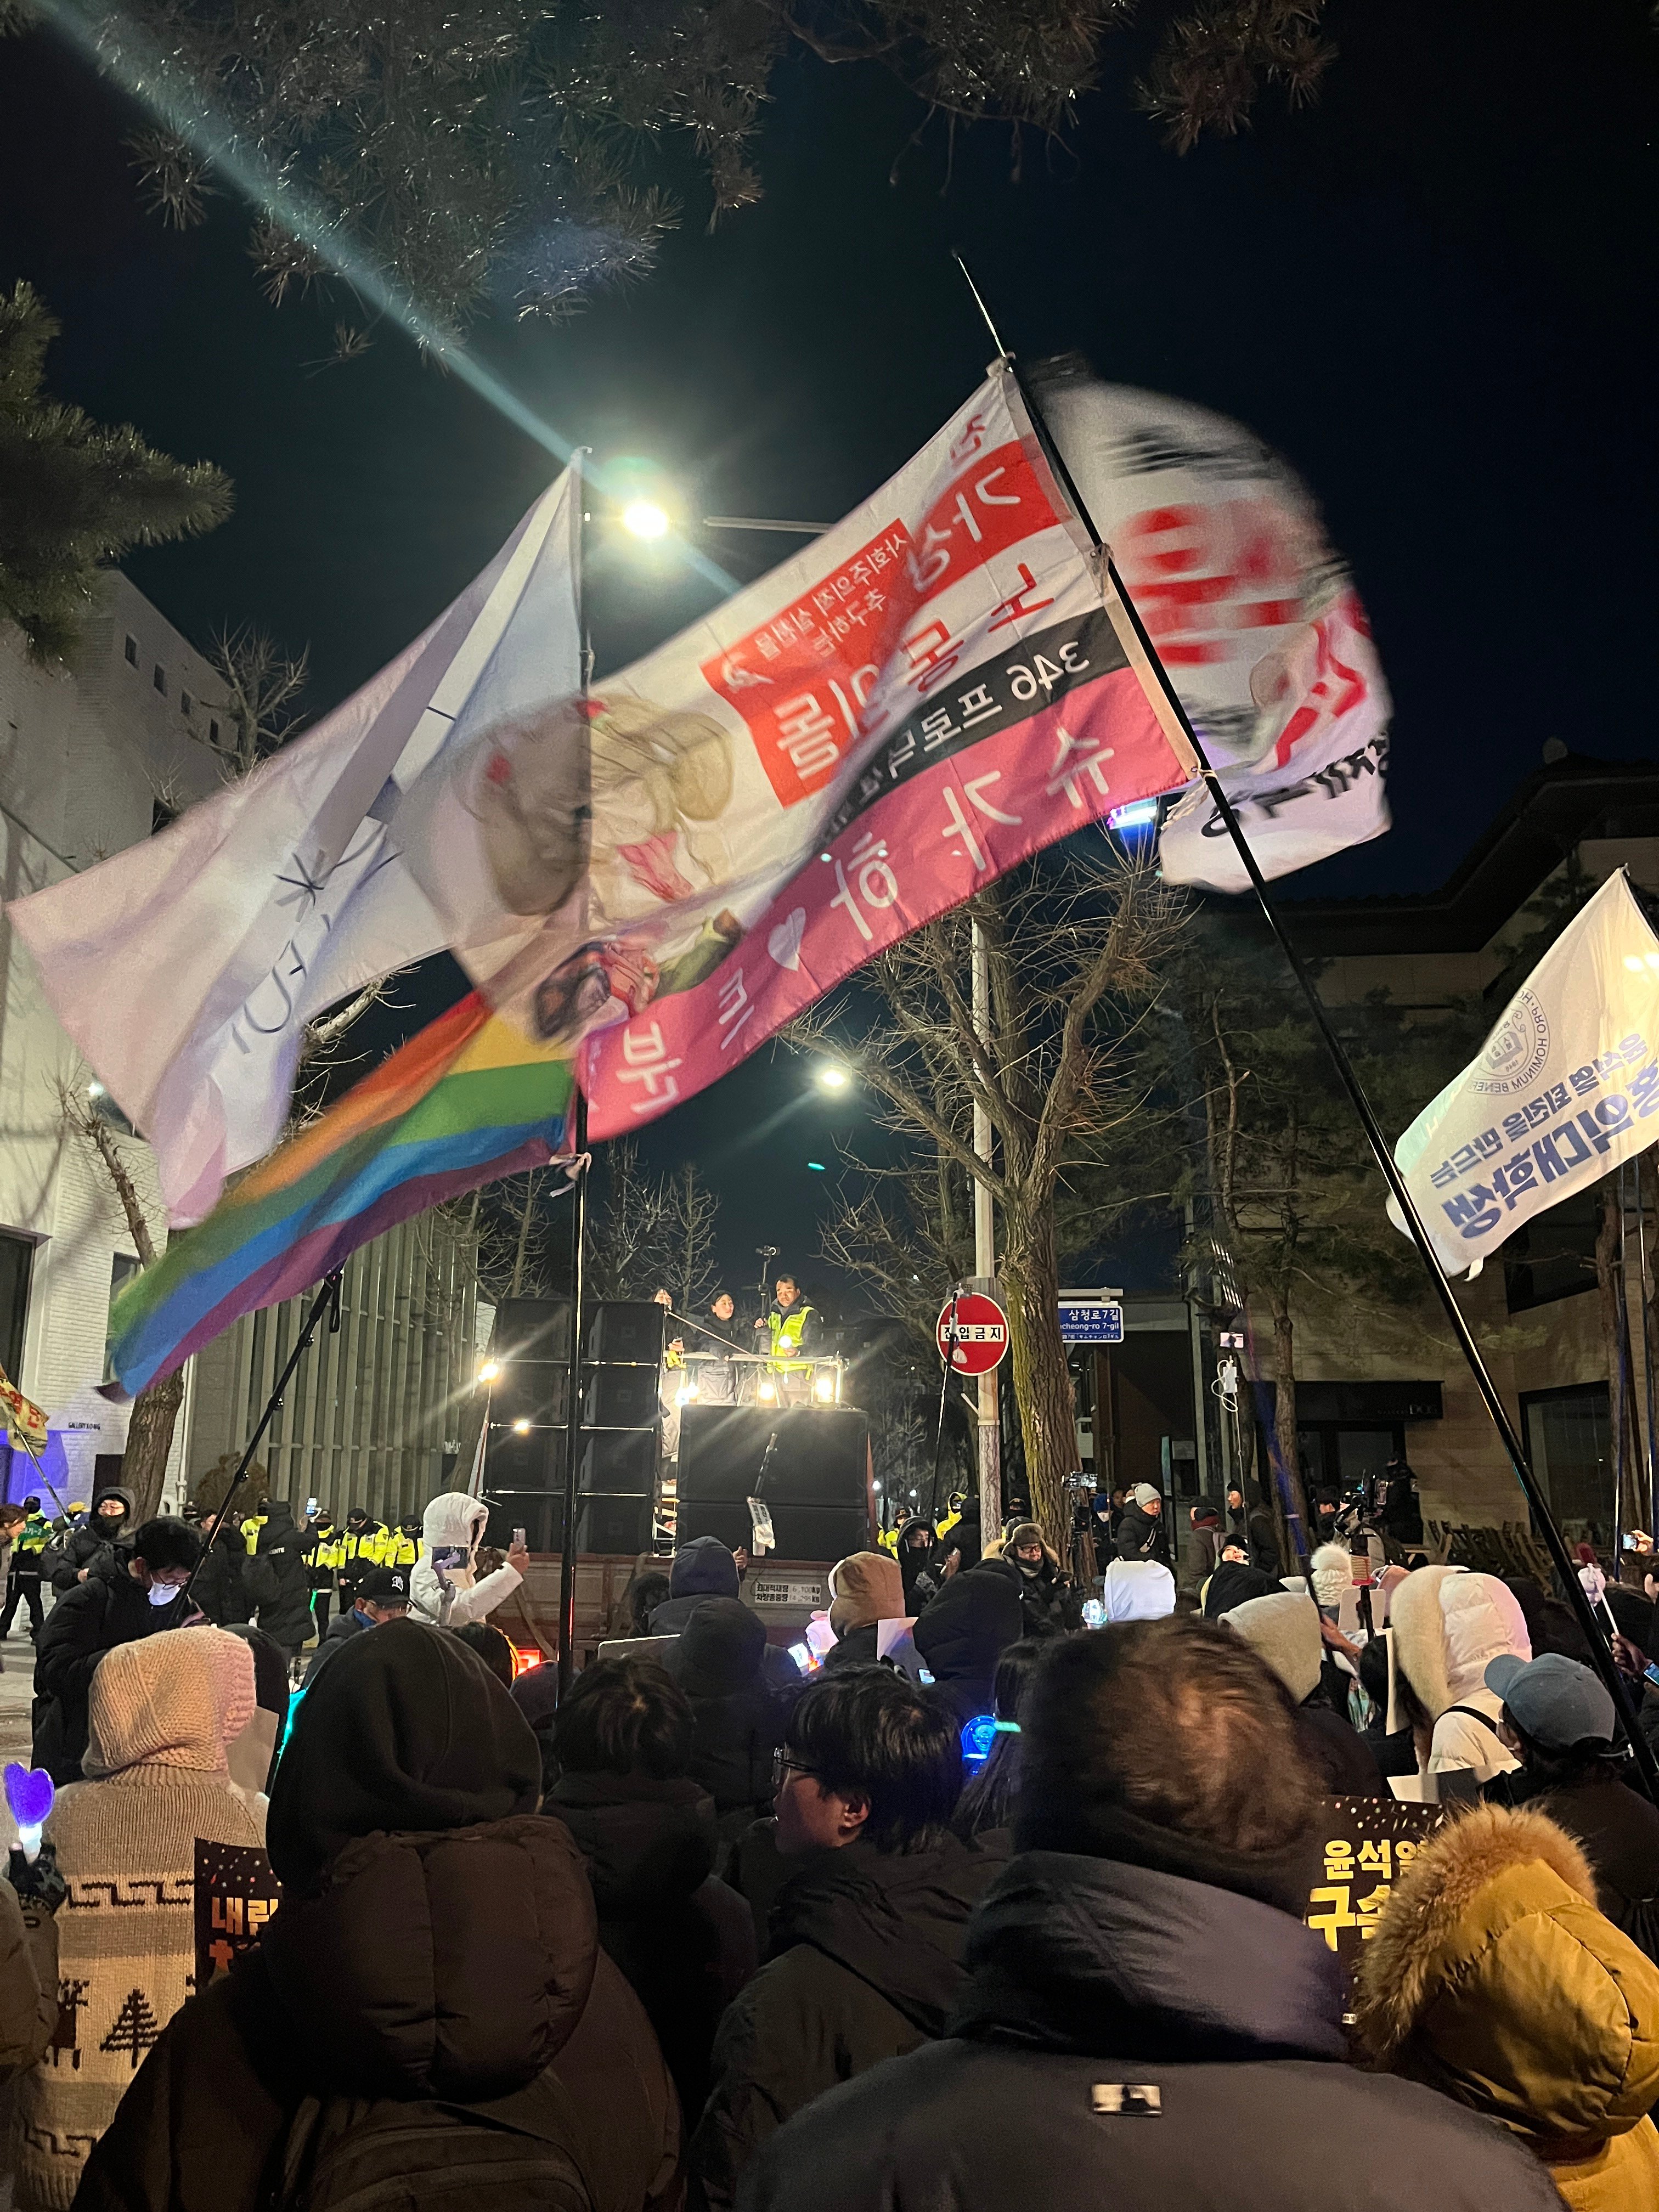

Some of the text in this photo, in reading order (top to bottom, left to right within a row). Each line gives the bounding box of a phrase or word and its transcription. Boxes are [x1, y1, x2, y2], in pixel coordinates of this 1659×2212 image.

[1069, 1309, 1119, 1321] 삼청로7길
[1060, 1322, 1119, 1331] cheong-ro 7-gil
